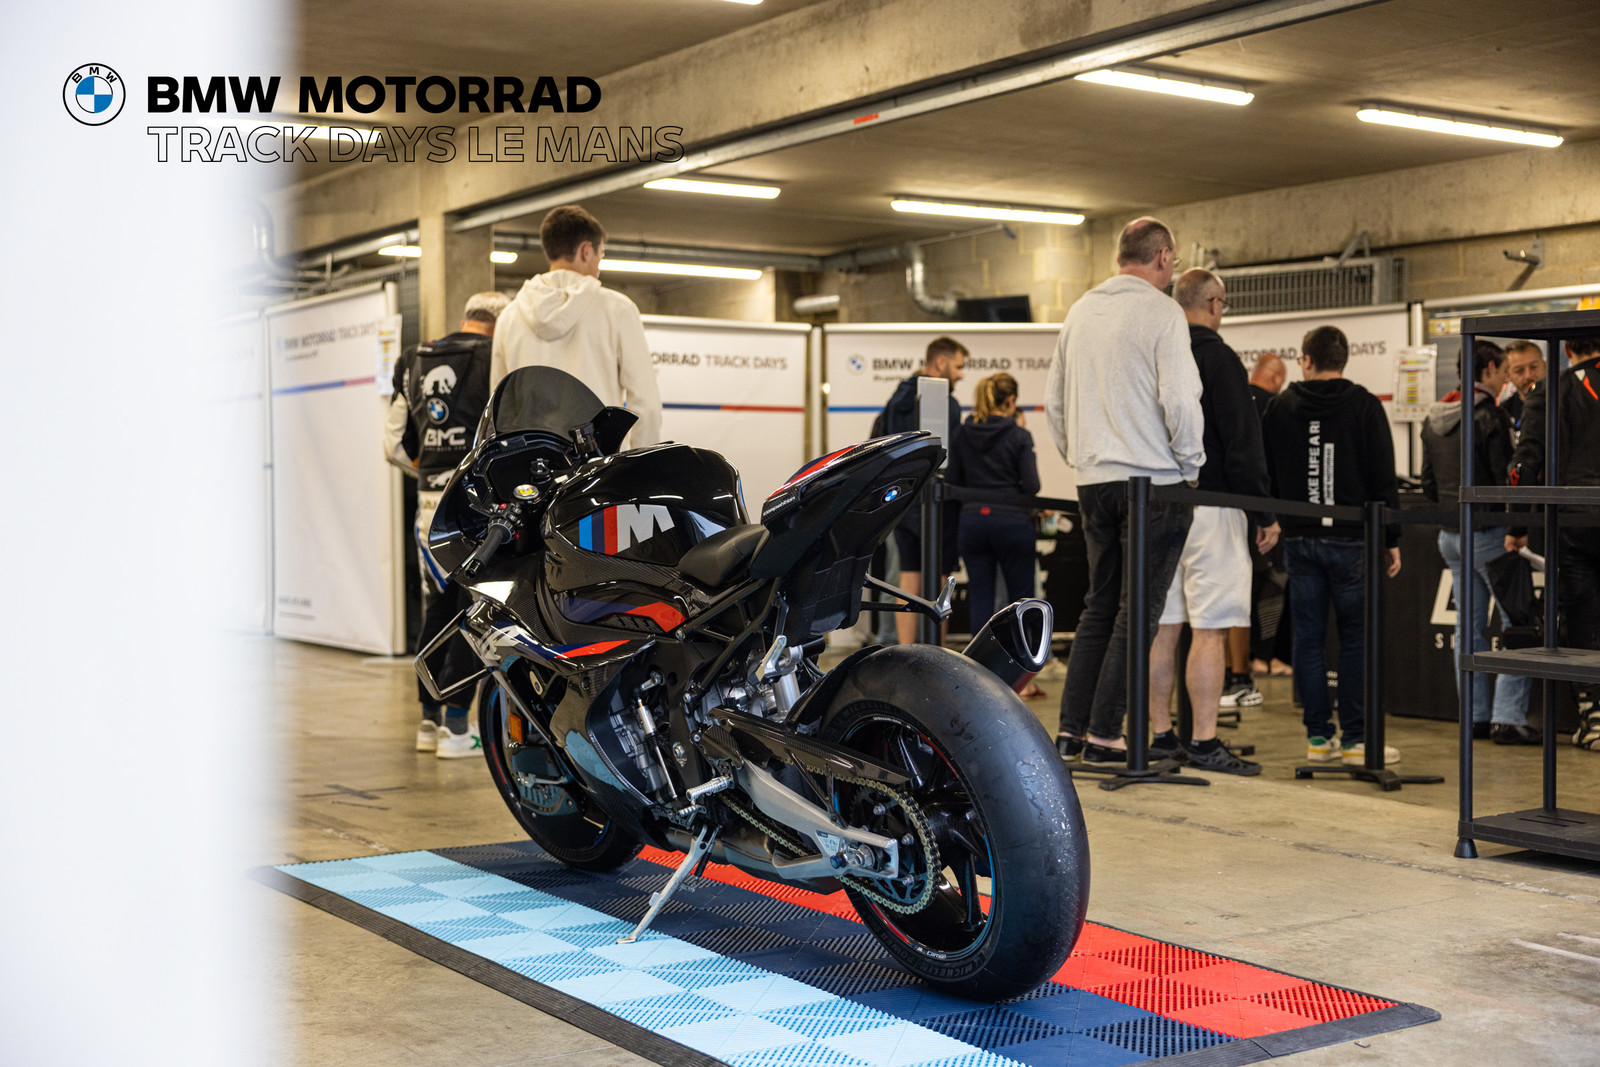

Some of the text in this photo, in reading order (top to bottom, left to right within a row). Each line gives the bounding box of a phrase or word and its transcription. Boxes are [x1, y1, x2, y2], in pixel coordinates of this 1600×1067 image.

[1350, 340, 1387, 356] DAYS
[651, 352, 788, 371] ORRAD TRACK DAYS
[872, 357, 914, 370] BMW
[424, 426, 466, 446] BMC
[1307, 420, 1321, 504] AKE LIFE A RI
[617, 504, 675, 553] M
